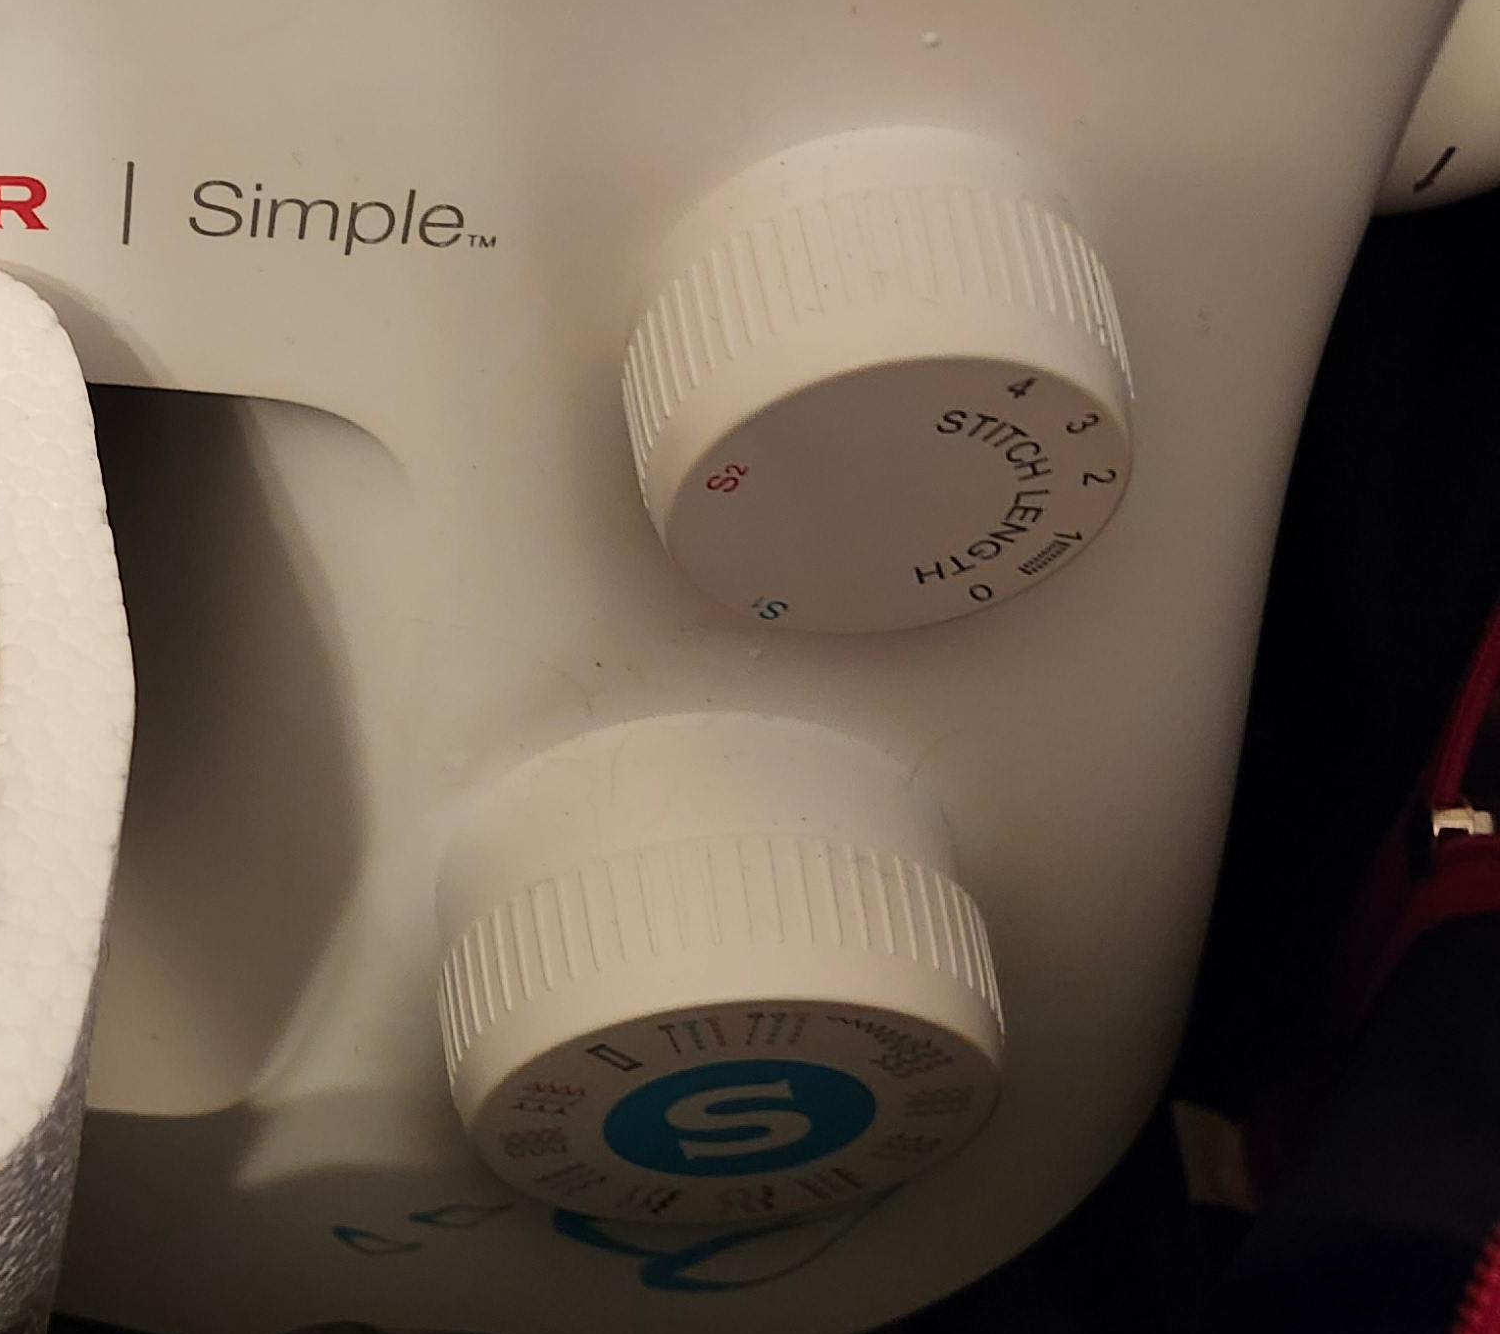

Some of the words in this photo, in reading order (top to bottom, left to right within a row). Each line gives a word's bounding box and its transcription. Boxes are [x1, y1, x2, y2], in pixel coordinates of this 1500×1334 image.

[1007, 377, 1037, 399] 4
[1066, 413, 1099, 435] 3
[936, 409, 1052, 482] STITCH
[1083, 468, 1117, 486] 2
[914, 488, 1050, 585] LENGTH
